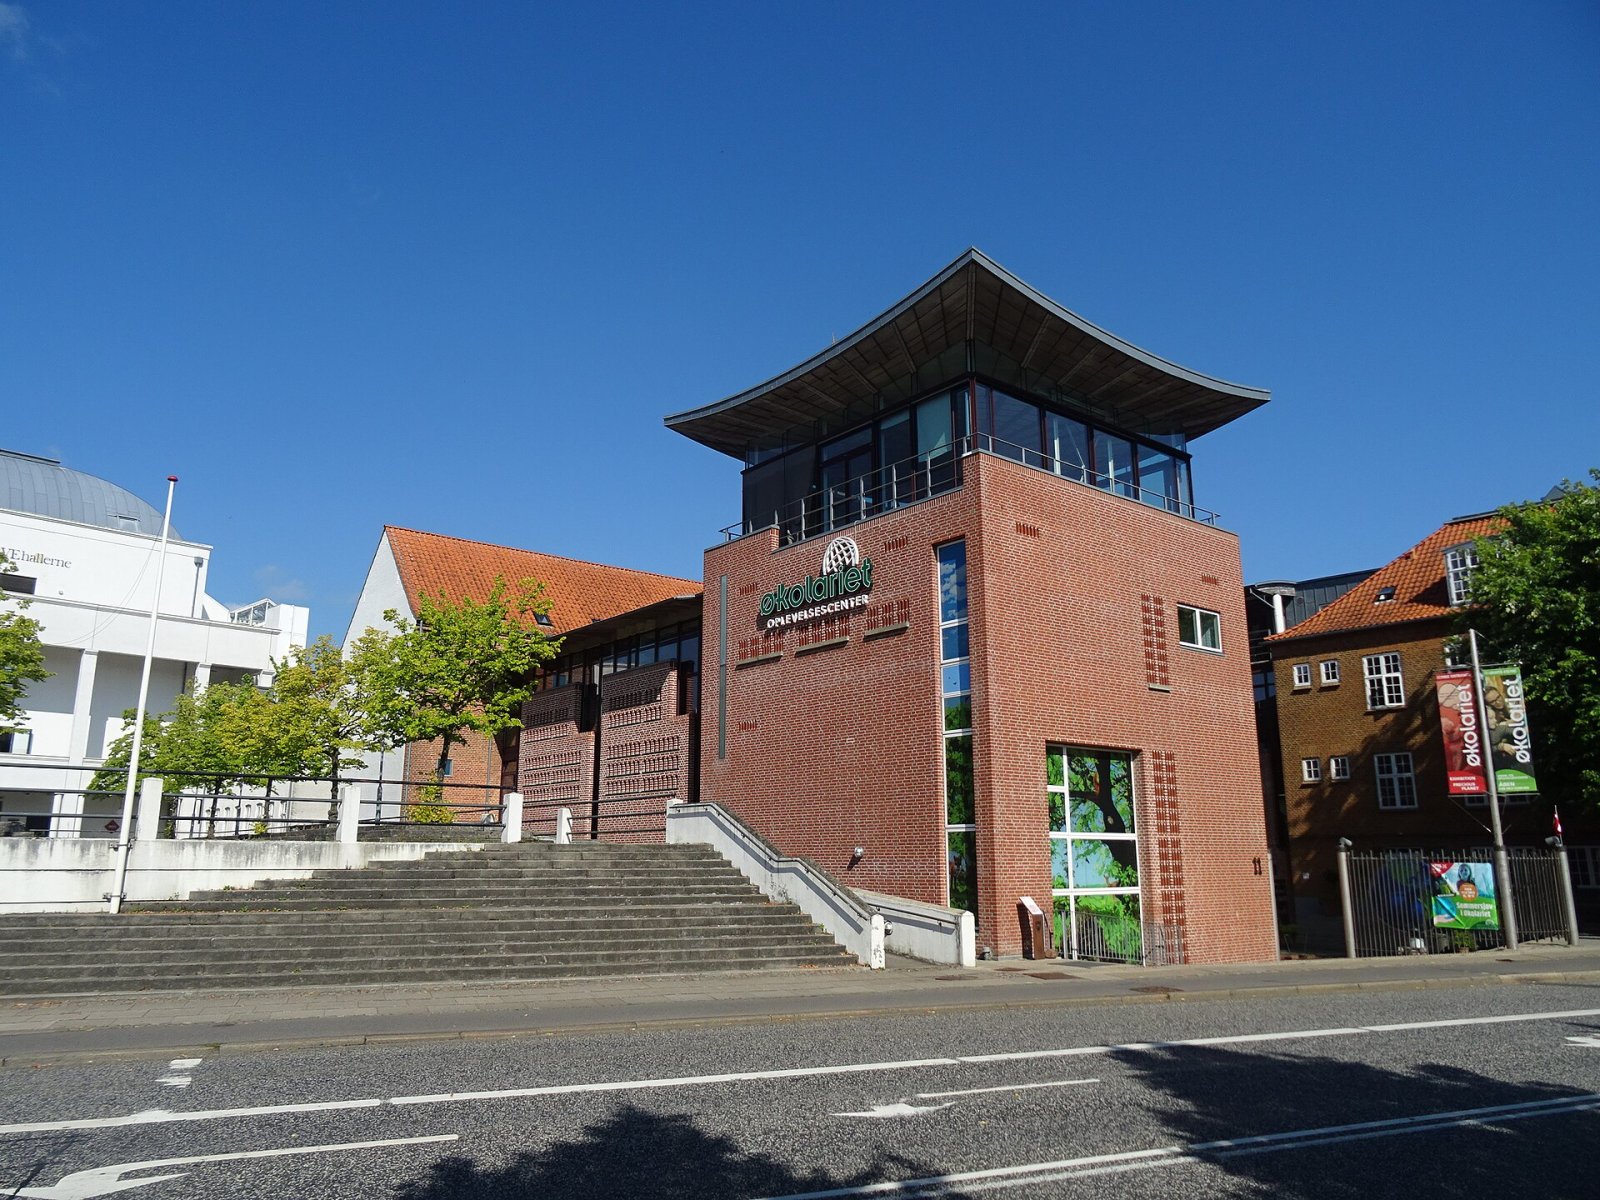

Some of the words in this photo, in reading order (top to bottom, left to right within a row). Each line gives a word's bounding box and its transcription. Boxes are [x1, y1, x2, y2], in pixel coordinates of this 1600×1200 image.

[760, 557, 873, 616] økolariet
[767, 594, 869, 629] OPLEVELSESCENTER
[1457, 683, 1481, 767] økolariet
[1502, 678, 1531, 763] økolariet
